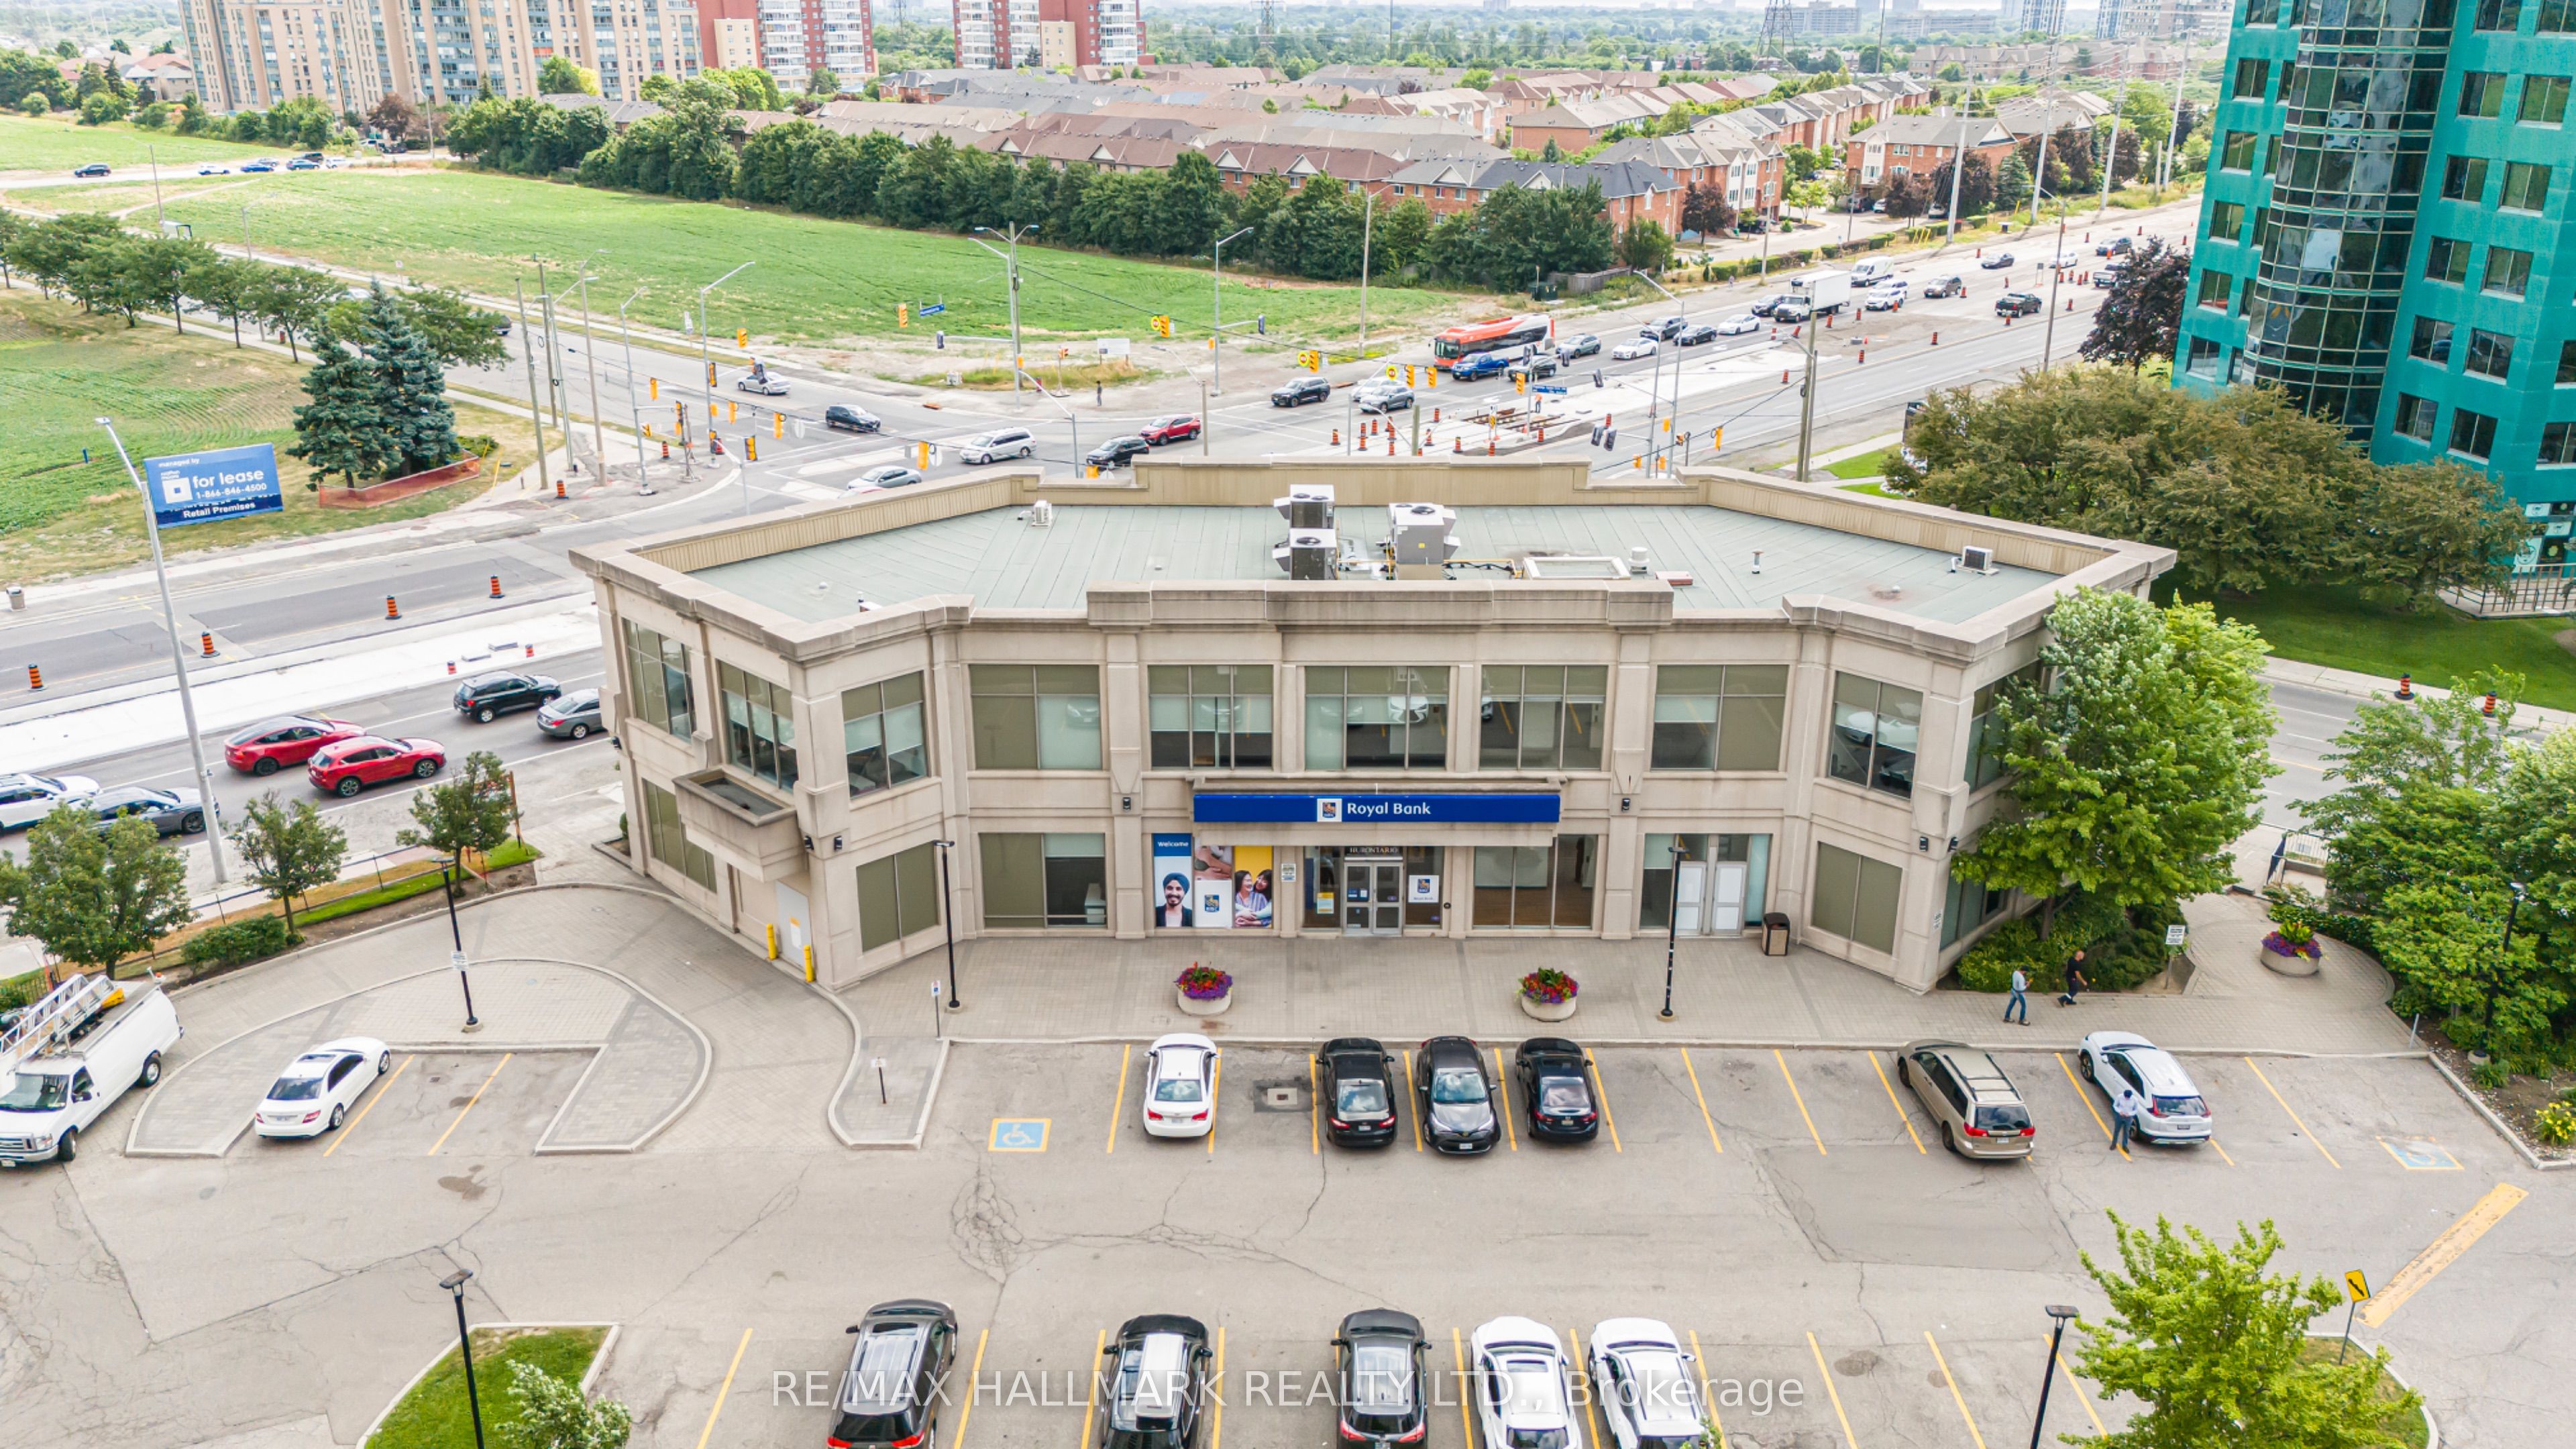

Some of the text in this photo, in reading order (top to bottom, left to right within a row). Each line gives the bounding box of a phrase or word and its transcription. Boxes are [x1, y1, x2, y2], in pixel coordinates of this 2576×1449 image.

[193, 470, 264, 488] for lease
[196, 483, 267, 498] 1-866-846-4500
[183, 502, 256, 518] Retail Premises
[1347, 802, 1432, 817] Royal Bank
